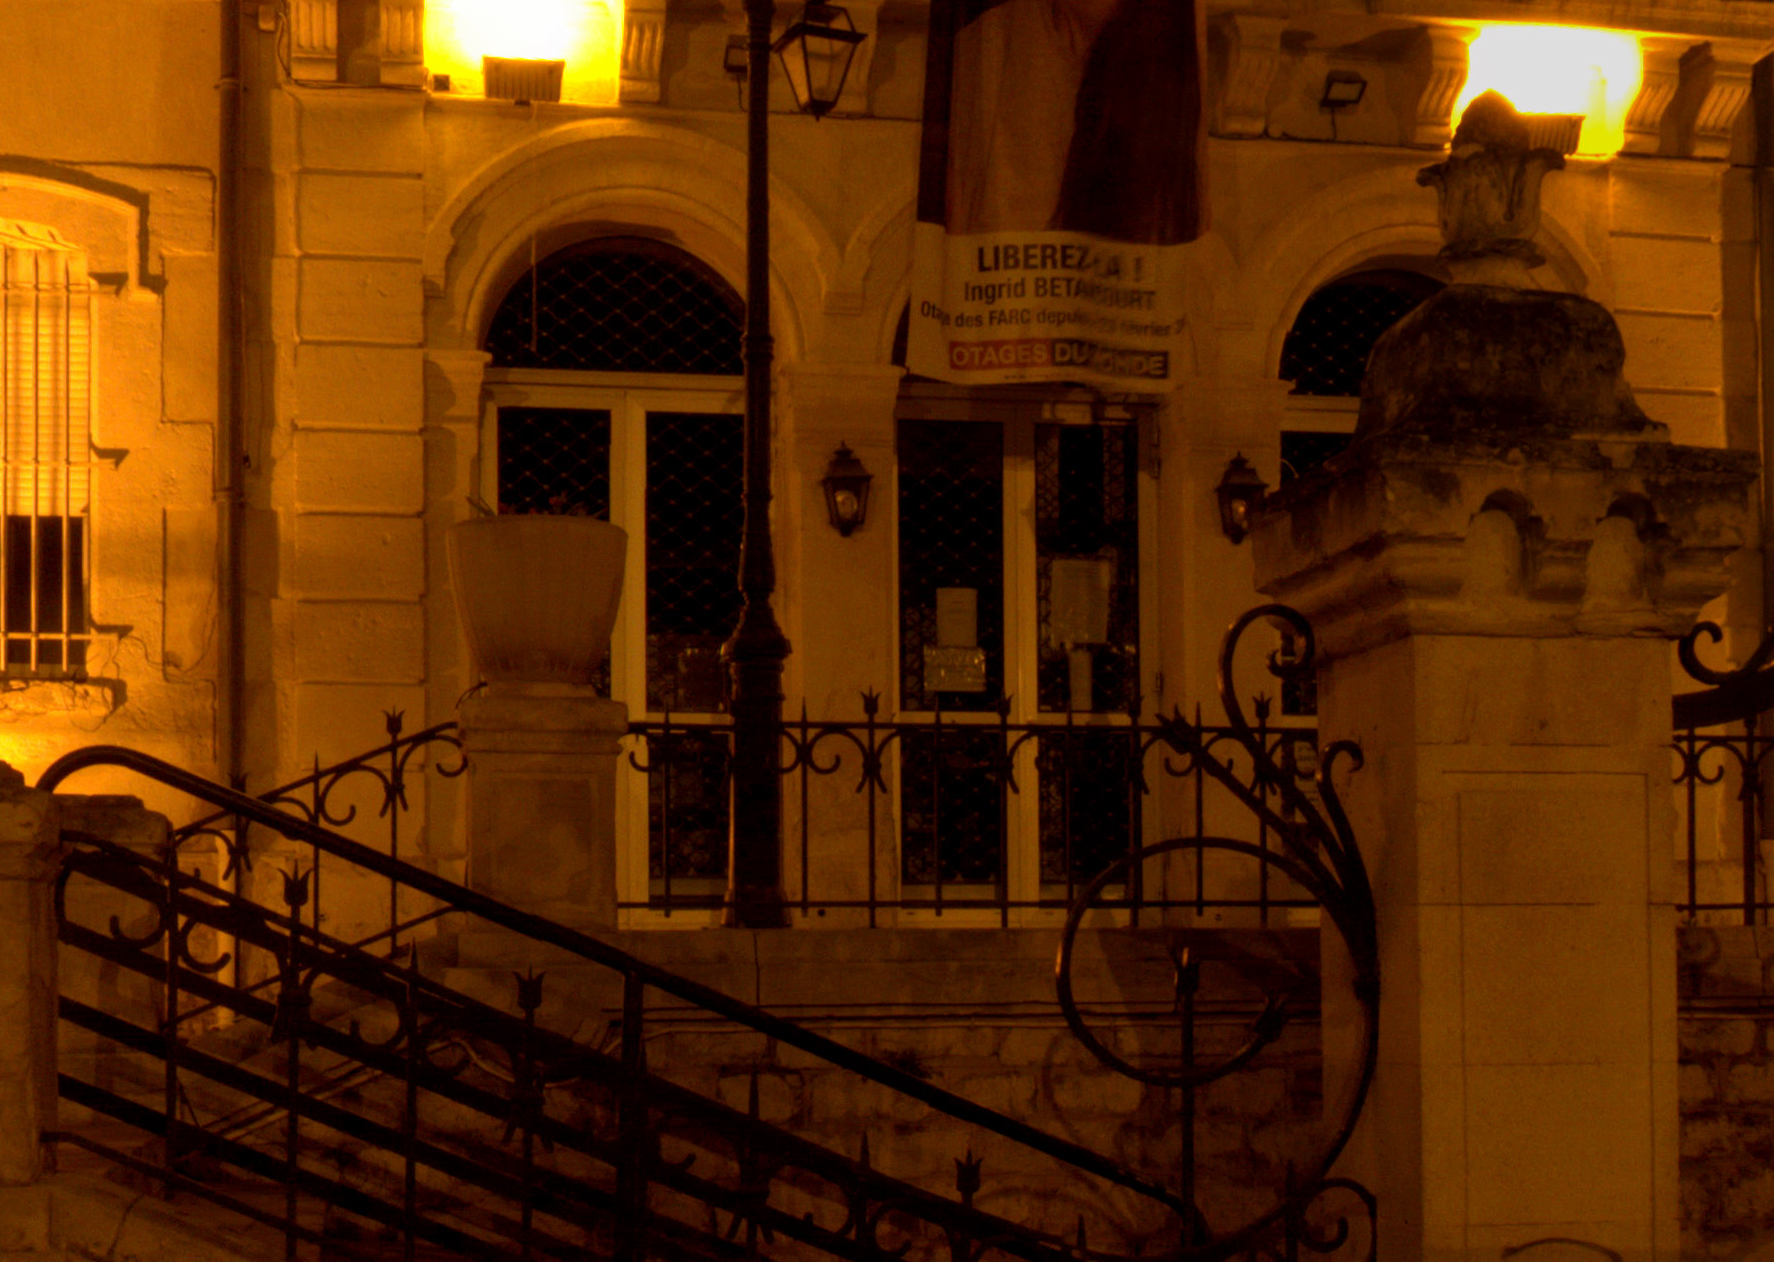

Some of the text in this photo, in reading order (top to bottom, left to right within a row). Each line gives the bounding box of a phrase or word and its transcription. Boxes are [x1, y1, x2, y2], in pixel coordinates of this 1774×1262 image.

[964, 278, 1026, 305] Ingrid
[955, 312, 983, 327] des
[988, 308, 1030, 327] FARC
[952, 343, 1048, 366] OTAGES
[1054, 342, 1090, 364] DU
